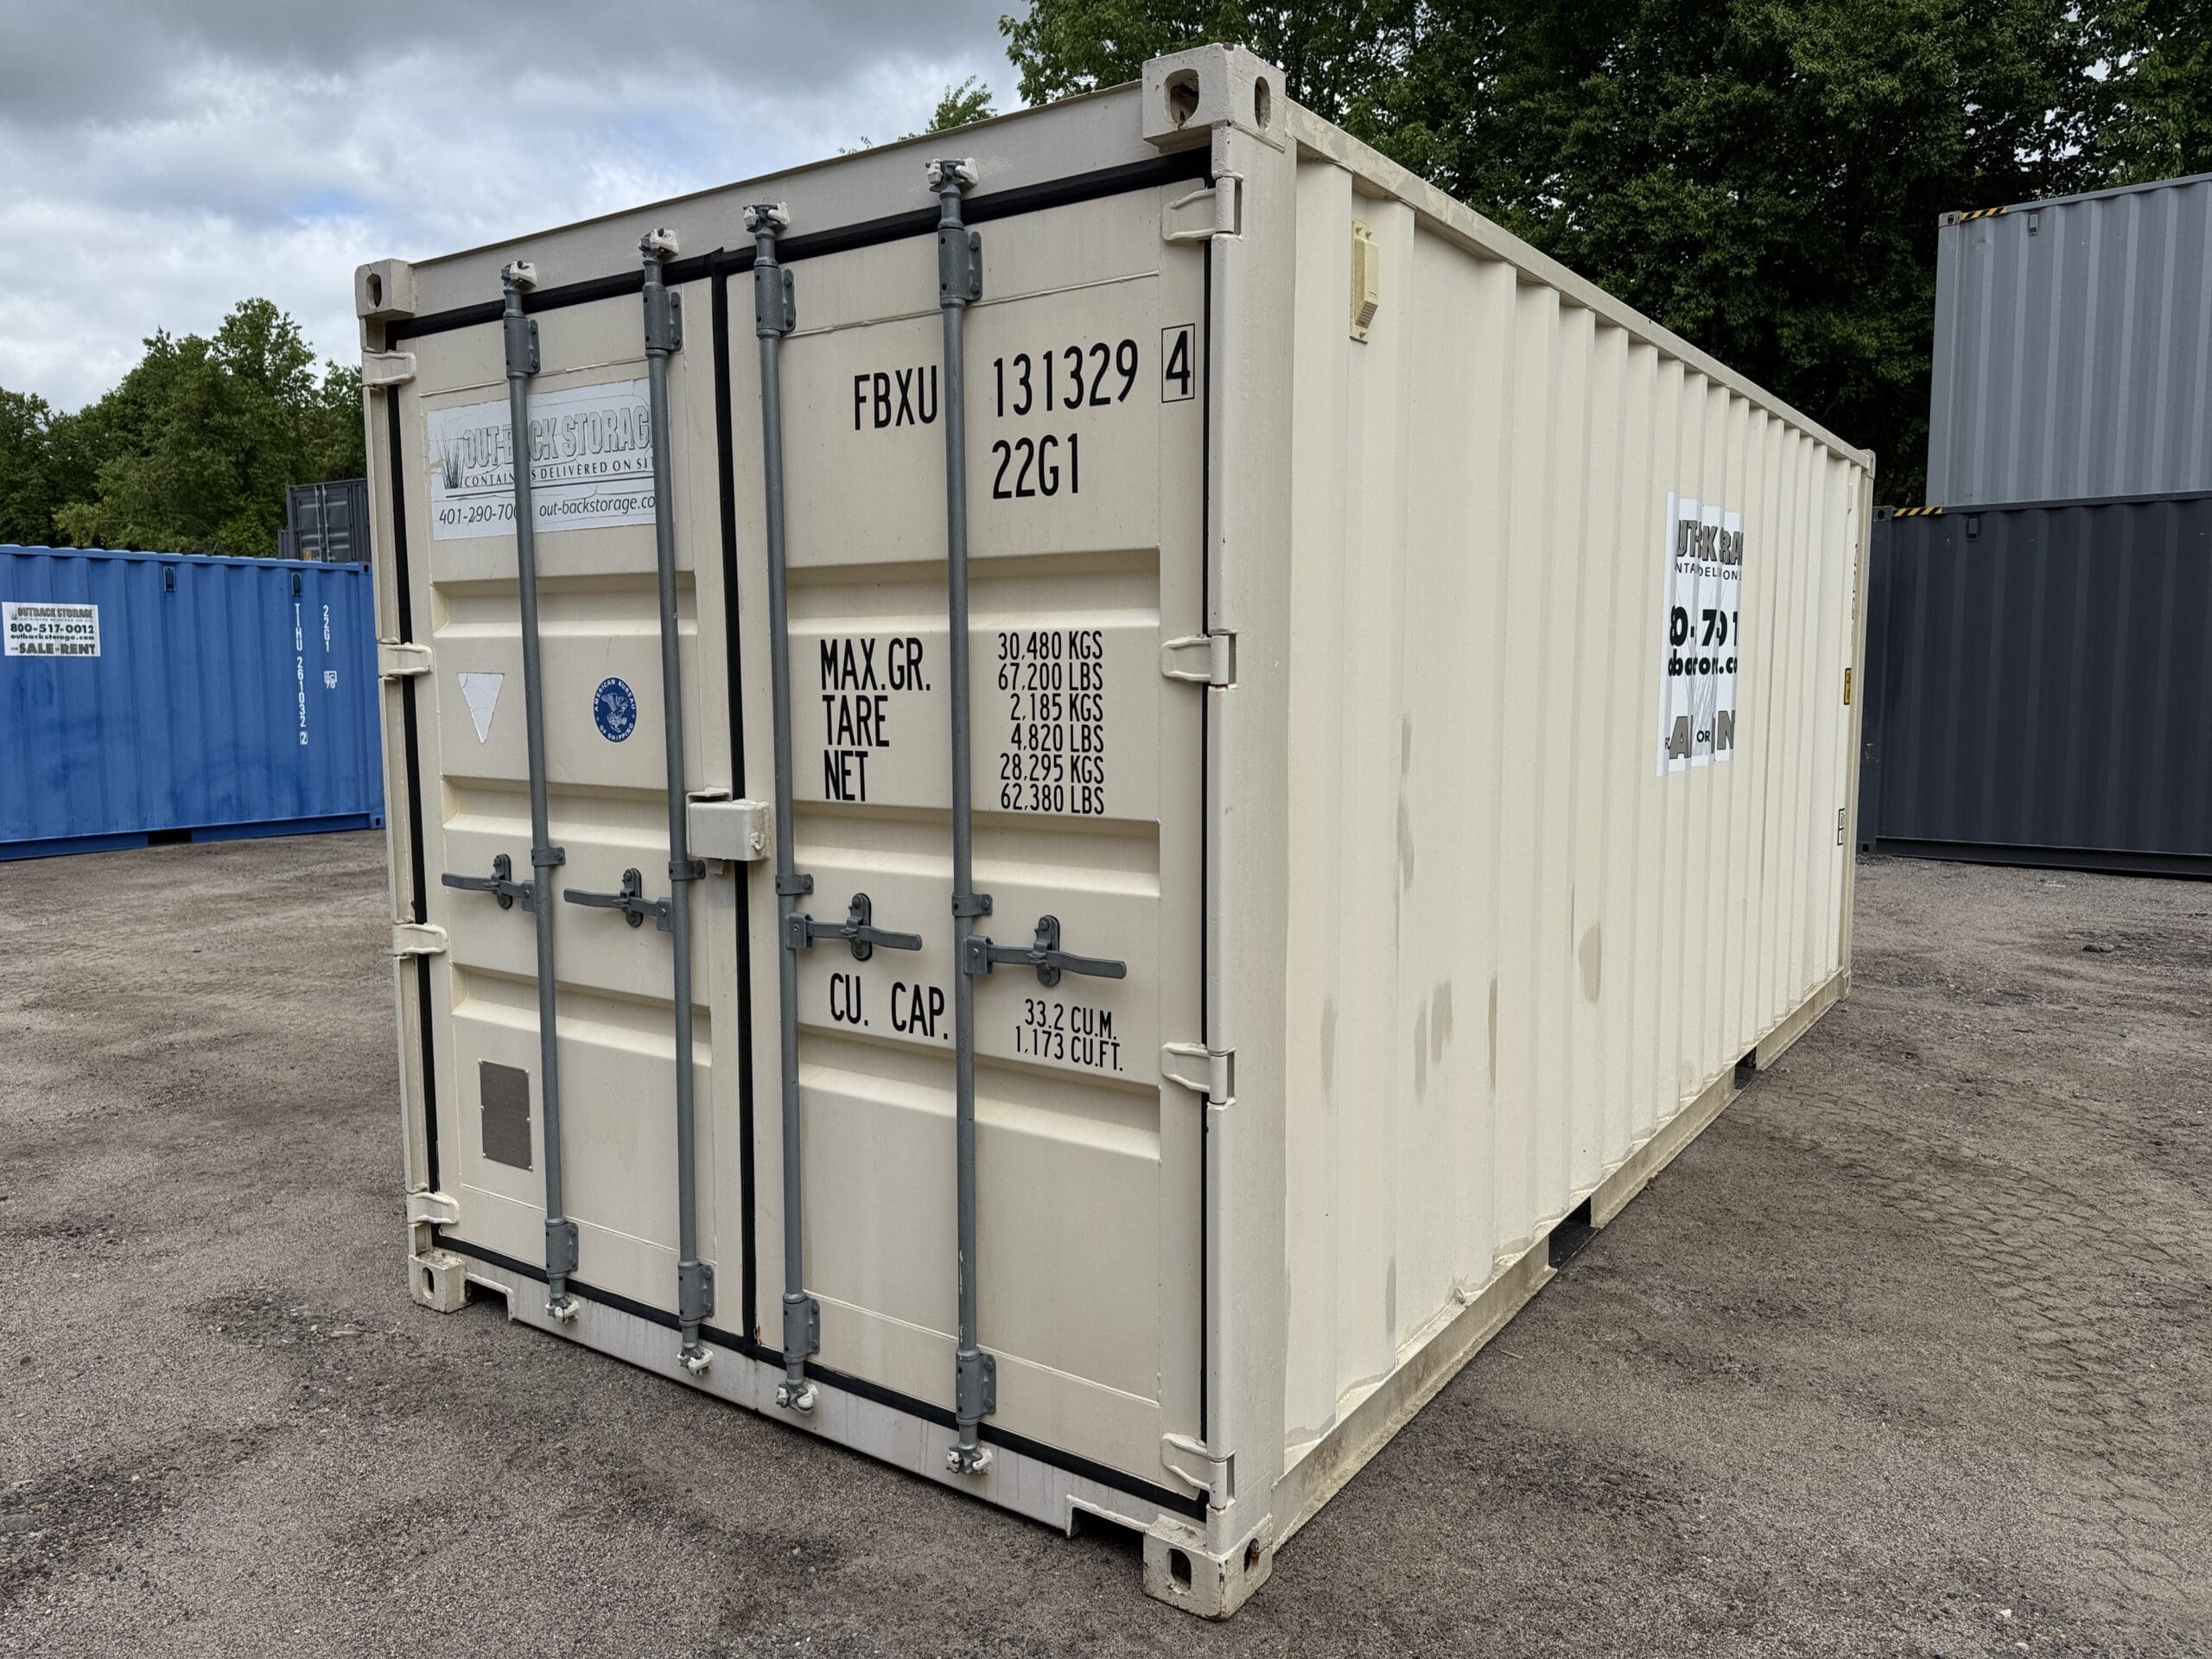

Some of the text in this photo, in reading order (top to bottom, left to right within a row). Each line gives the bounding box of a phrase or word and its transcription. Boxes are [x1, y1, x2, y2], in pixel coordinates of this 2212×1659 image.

[854, 330, 1190, 430] FBXU 131329 4
[463, 405, 653, 468] OUT-BCK STORAG
[541, 461, 607, 479] DELIVERED
[613, 459, 631, 471] ON
[992, 433, 1078, 499] 22G1
[539, 496, 656, 517] out-backstorage.co
[10, 623, 94, 633] 800-517-0012
[18, 607, 92, 618] OUTBACK STORAGE
[19, 643, 54, 654] SALE
[60, 644, 95, 654] RENT
[998, 631, 1103, 660] 30,480 KGS
[820, 637, 931, 690] MAX.GR.
[998, 663, 1103, 690] 67,200 LBS
[296, 657, 306, 727] 261032
[594, 679, 635, 712] AMERICAN BUREAU
[1010, 693, 1103, 721] 2,185 KGS
[823, 695, 889, 747] TARE
[1696, 730, 1711, 743] OR
[300, 732, 308, 745] 2
[1011, 723, 1103, 753] 4,820 LBS
[824, 750, 868, 801] NET
[1000, 753, 1104, 784] 28,295 KGS
[1001, 783, 1104, 814] 62,380 LBS
[830, 972, 949, 1039] CU. CAP.
[1025, 998, 1117, 1040] 33.2 CU.M.
[1015, 1025, 1123, 1071] 1,173 CU.FT.
